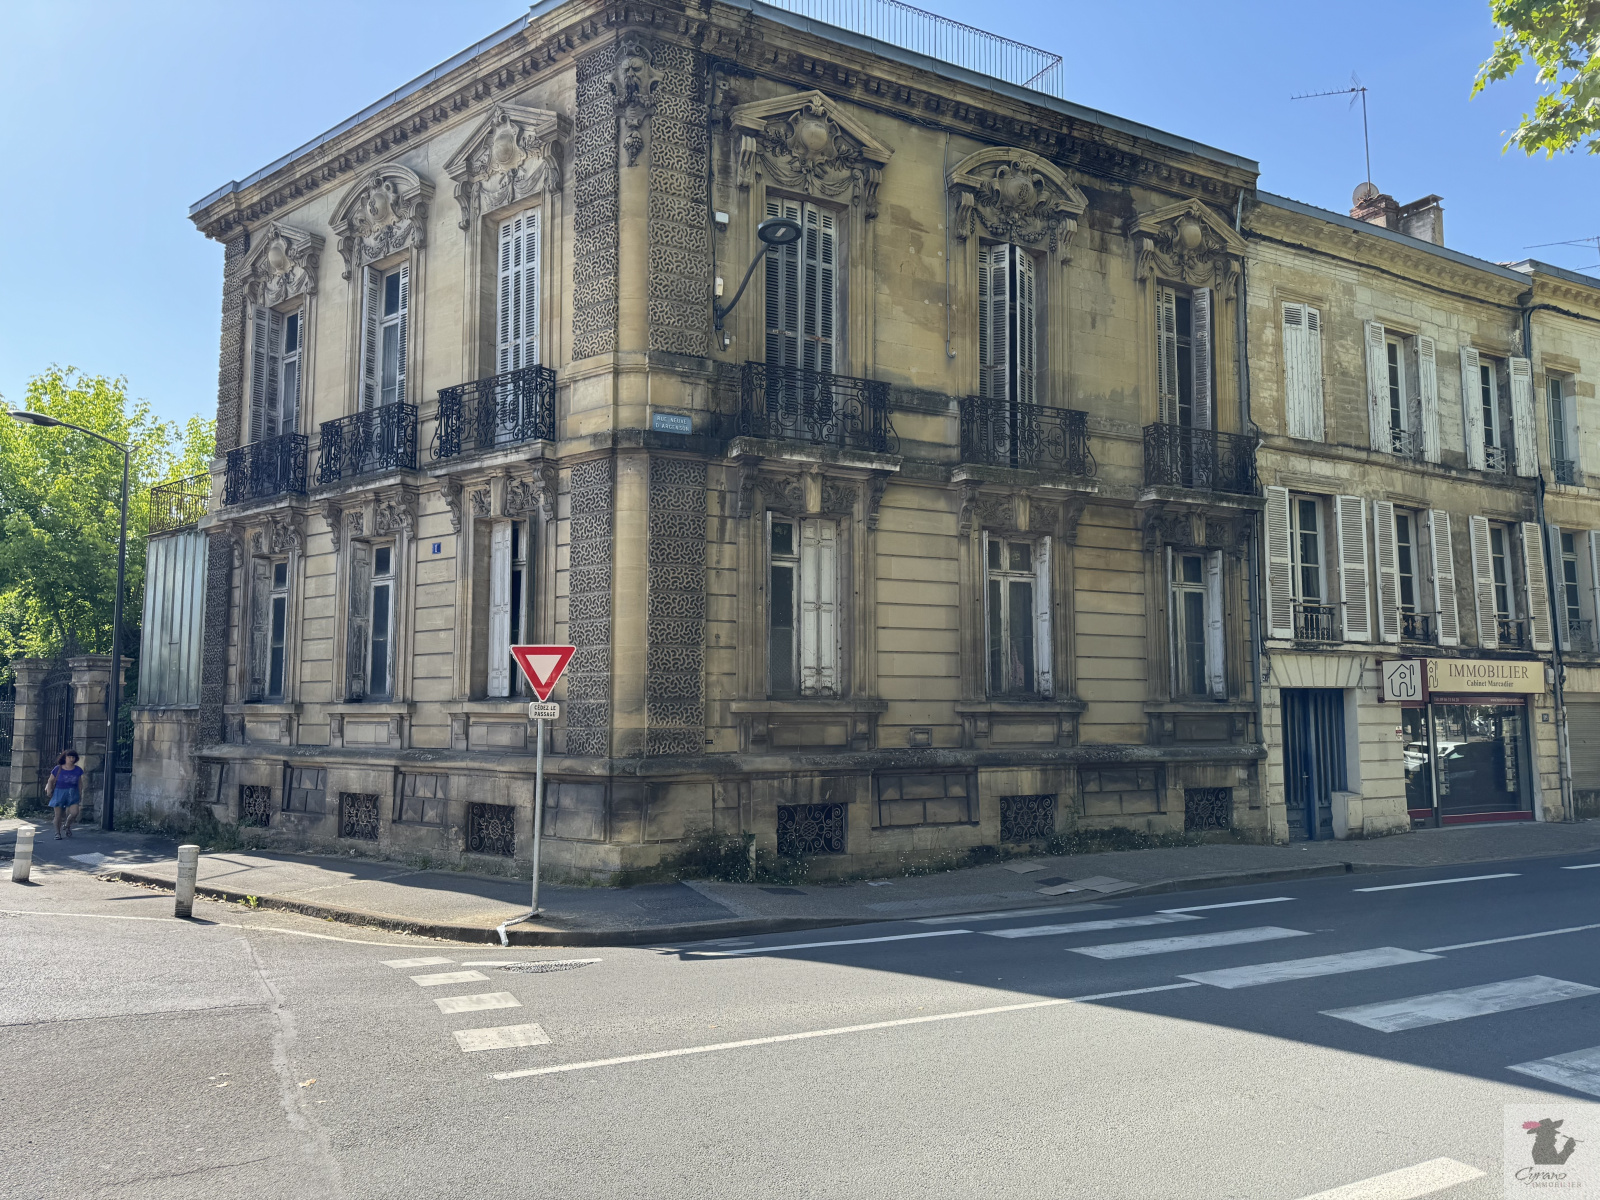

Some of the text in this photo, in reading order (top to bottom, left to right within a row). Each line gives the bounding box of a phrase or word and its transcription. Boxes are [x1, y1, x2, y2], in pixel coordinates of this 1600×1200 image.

[656, 415, 687, 425] RUE NEUVE
[1448, 663, 1529, 679] IMMOBILIER
[1488, 680, 1514, 688] Marcadier
